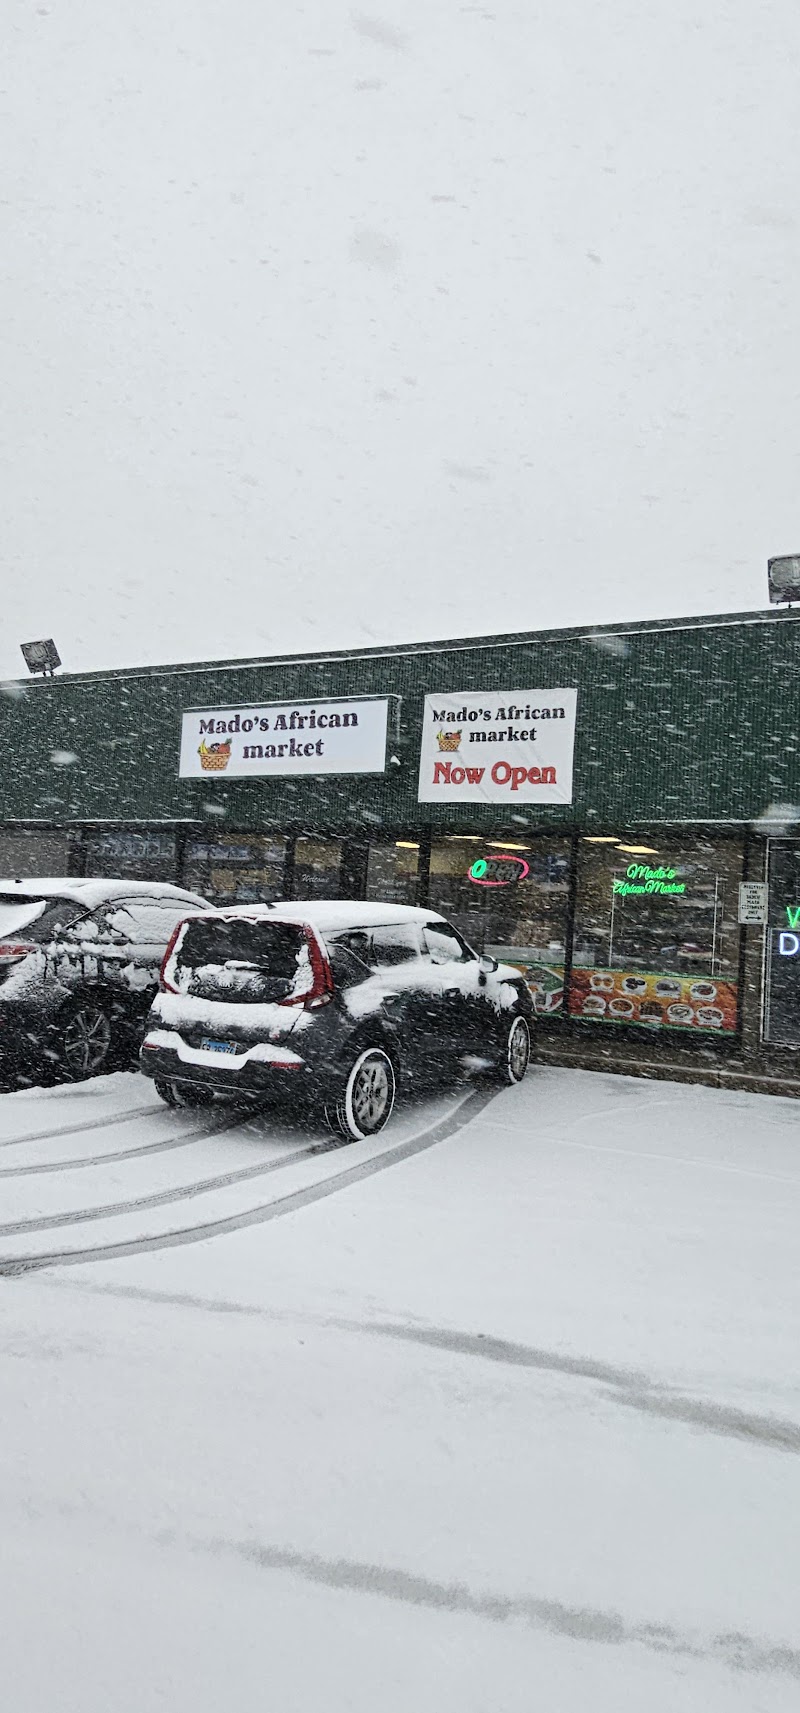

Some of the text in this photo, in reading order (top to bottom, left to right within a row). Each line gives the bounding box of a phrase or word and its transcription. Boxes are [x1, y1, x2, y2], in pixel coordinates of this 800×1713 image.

[199, 710, 358, 734] Mado's African
[432, 705, 565, 722] Mado's African
[469, 726, 537, 742] market
[242, 738, 325, 759] market
[432, 761, 557, 790] Now Open
[613, 880, 687, 896] African Market
